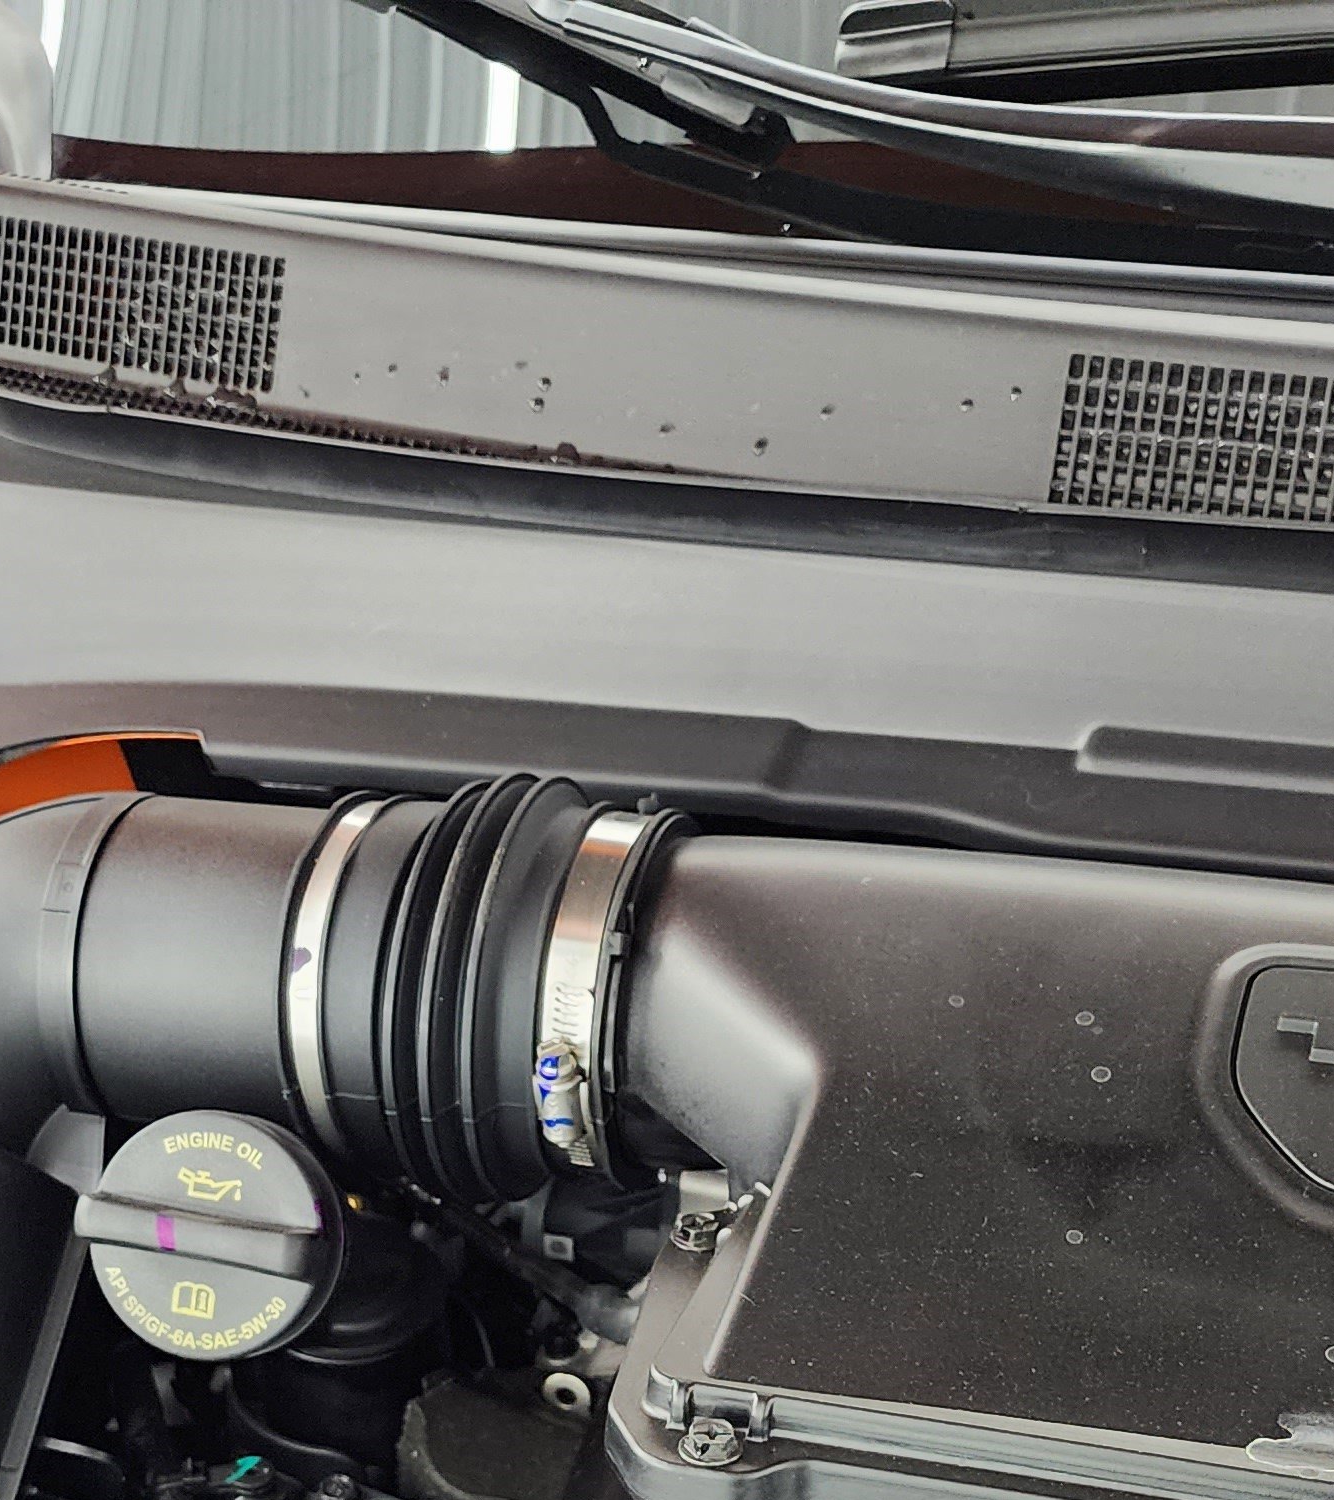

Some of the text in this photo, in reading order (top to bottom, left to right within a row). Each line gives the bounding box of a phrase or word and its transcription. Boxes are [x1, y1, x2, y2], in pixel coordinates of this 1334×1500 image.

[163, 1132, 264, 1171] ENGINE OIL
[105, 1265, 129, 1297] API
